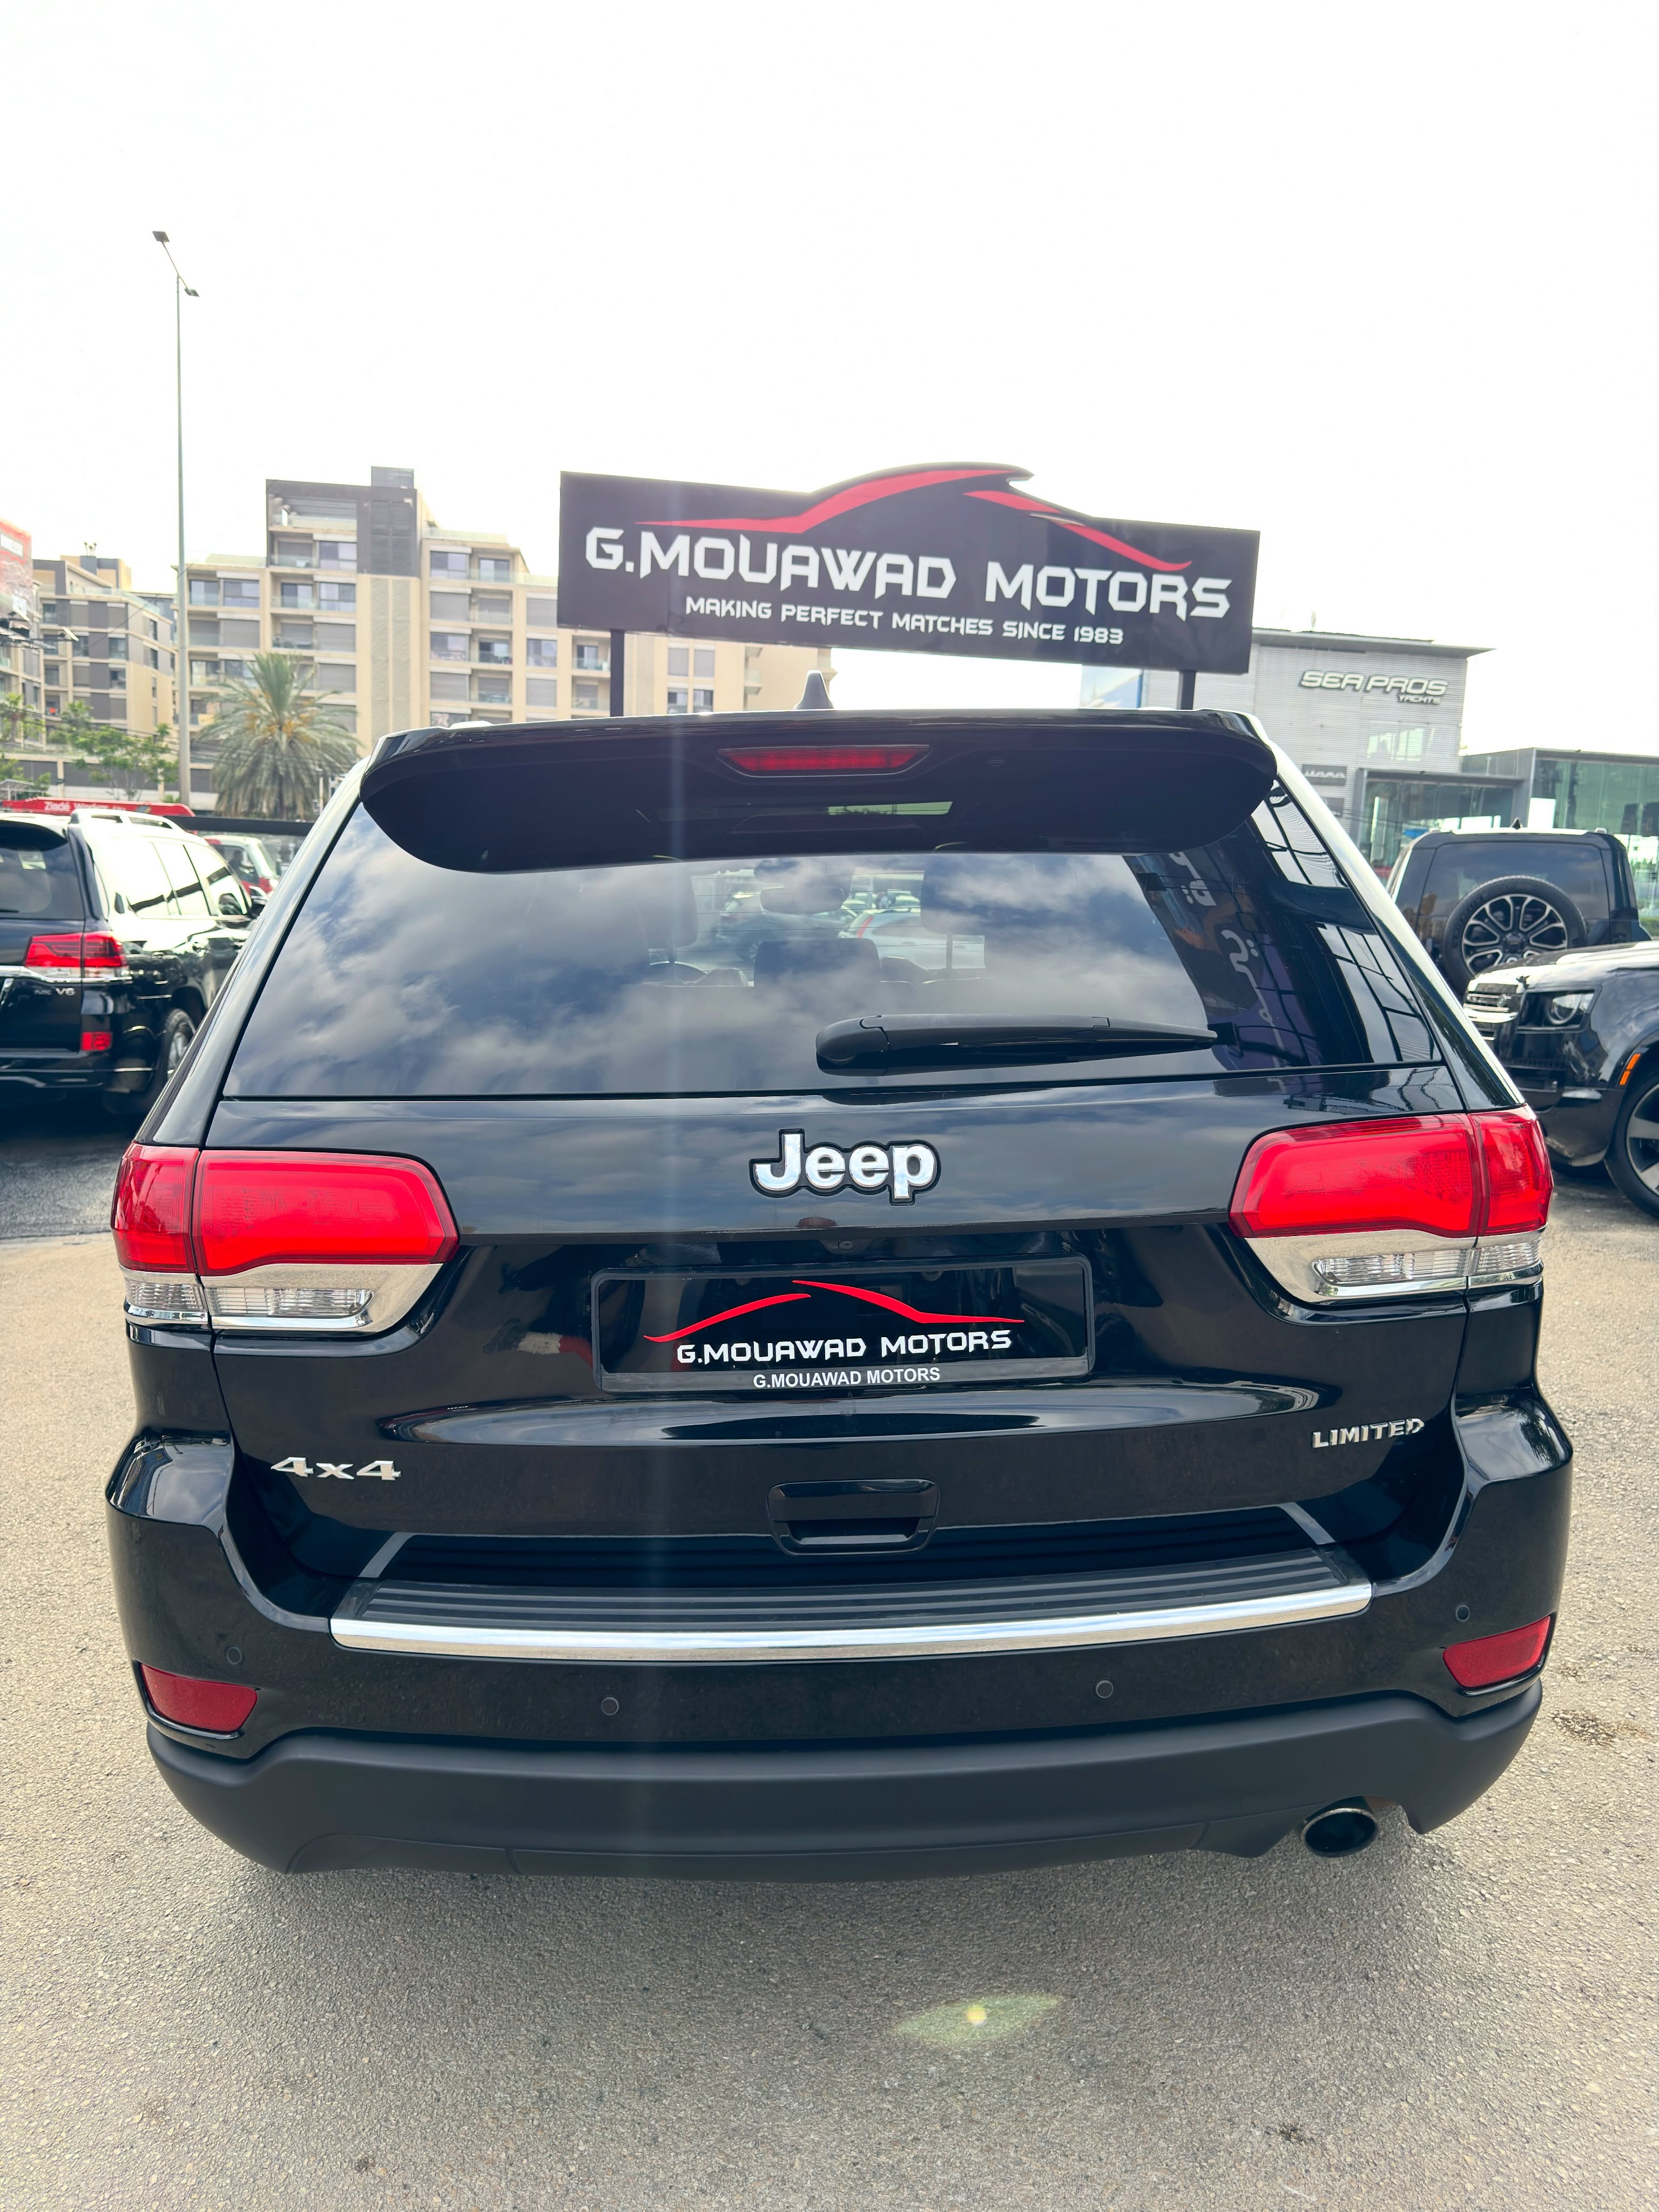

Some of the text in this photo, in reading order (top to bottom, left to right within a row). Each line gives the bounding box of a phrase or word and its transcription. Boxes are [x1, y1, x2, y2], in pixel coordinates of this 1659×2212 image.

[585, 526, 1232, 622] G.MOUAWAD MOTORS
[685, 596, 1124, 645] MAKING PERFECT MATCHES SINCE 1983
[1300, 671, 1365, 691] SEA
[55, 987, 75, 996] V6
[753, 1131, 939, 1202] Jeep
[677, 1329, 1011, 1365] G.MOUAWAD MOTORS
[753, 1366, 941, 1390] G.MOUAWAD MOTORS
[1312, 1418, 1425, 1448] LIMITED
[271, 1456, 401, 1480] 4x4
